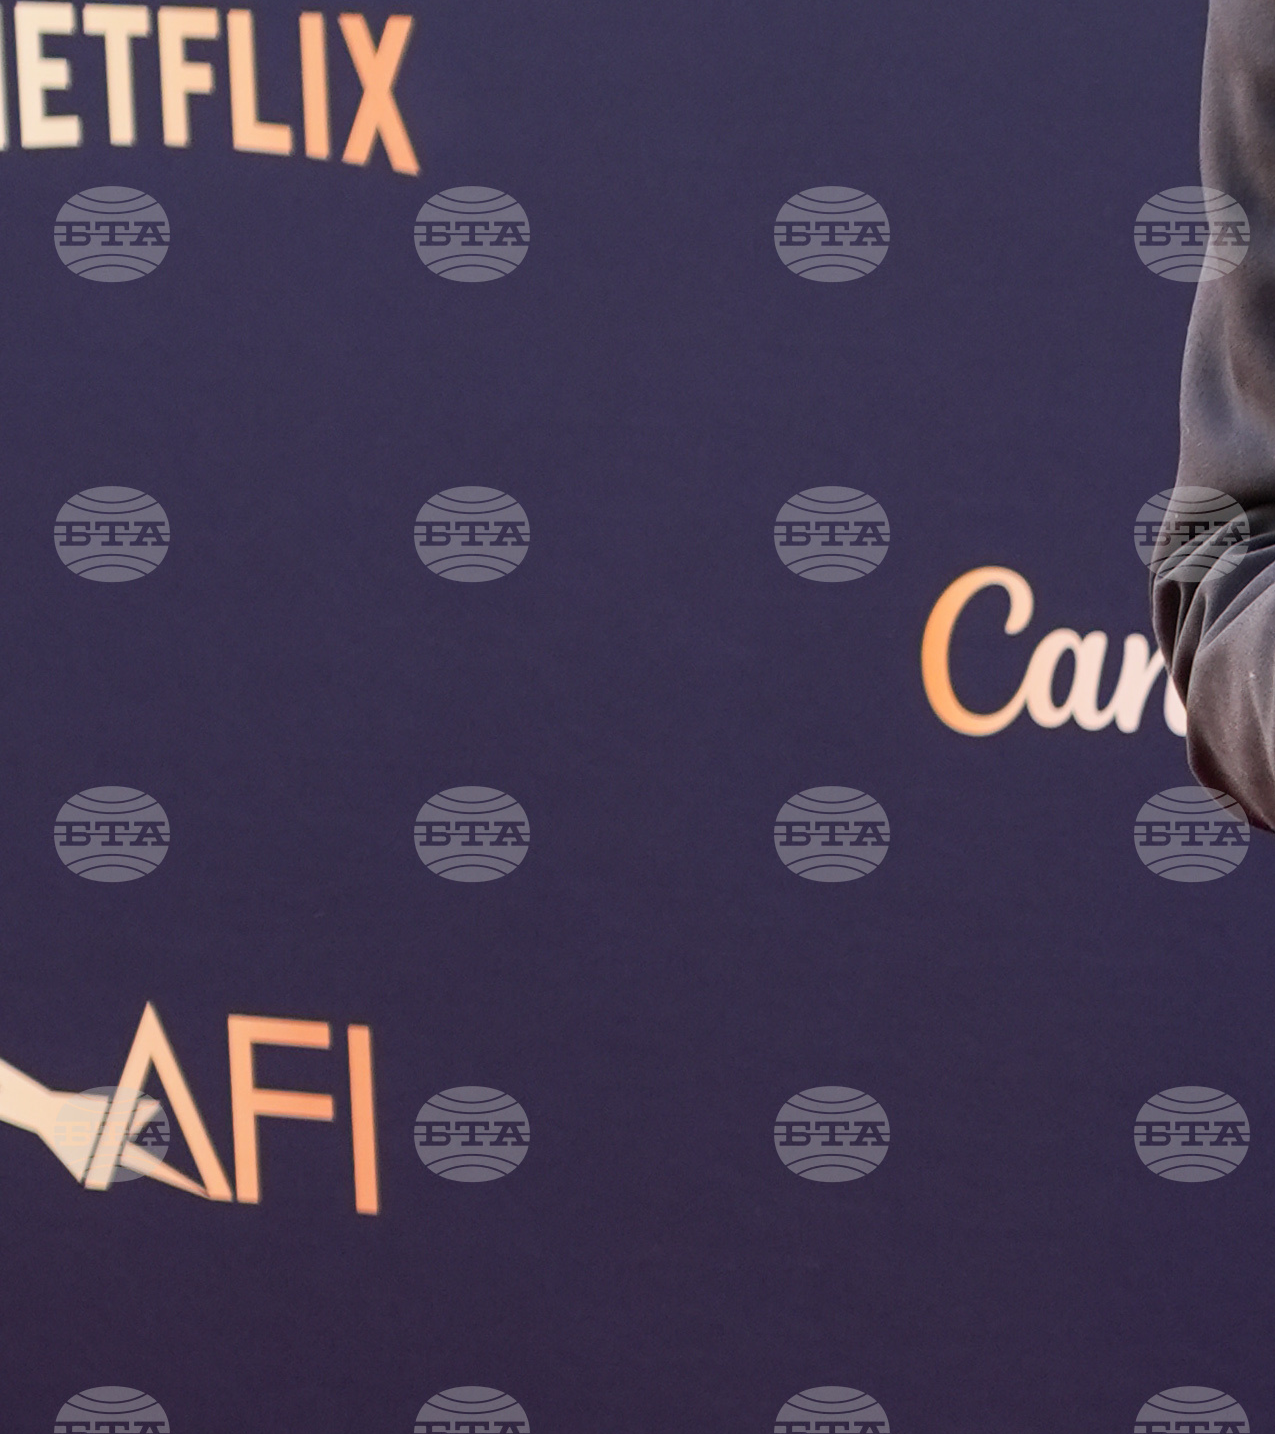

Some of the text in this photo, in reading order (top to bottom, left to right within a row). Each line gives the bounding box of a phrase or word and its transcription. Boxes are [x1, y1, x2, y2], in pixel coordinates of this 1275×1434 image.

[0, 0, 420, 177] ETFLIX
[921, 565, 1187, 737] Can
[84, 1000, 380, 1216] AFI
